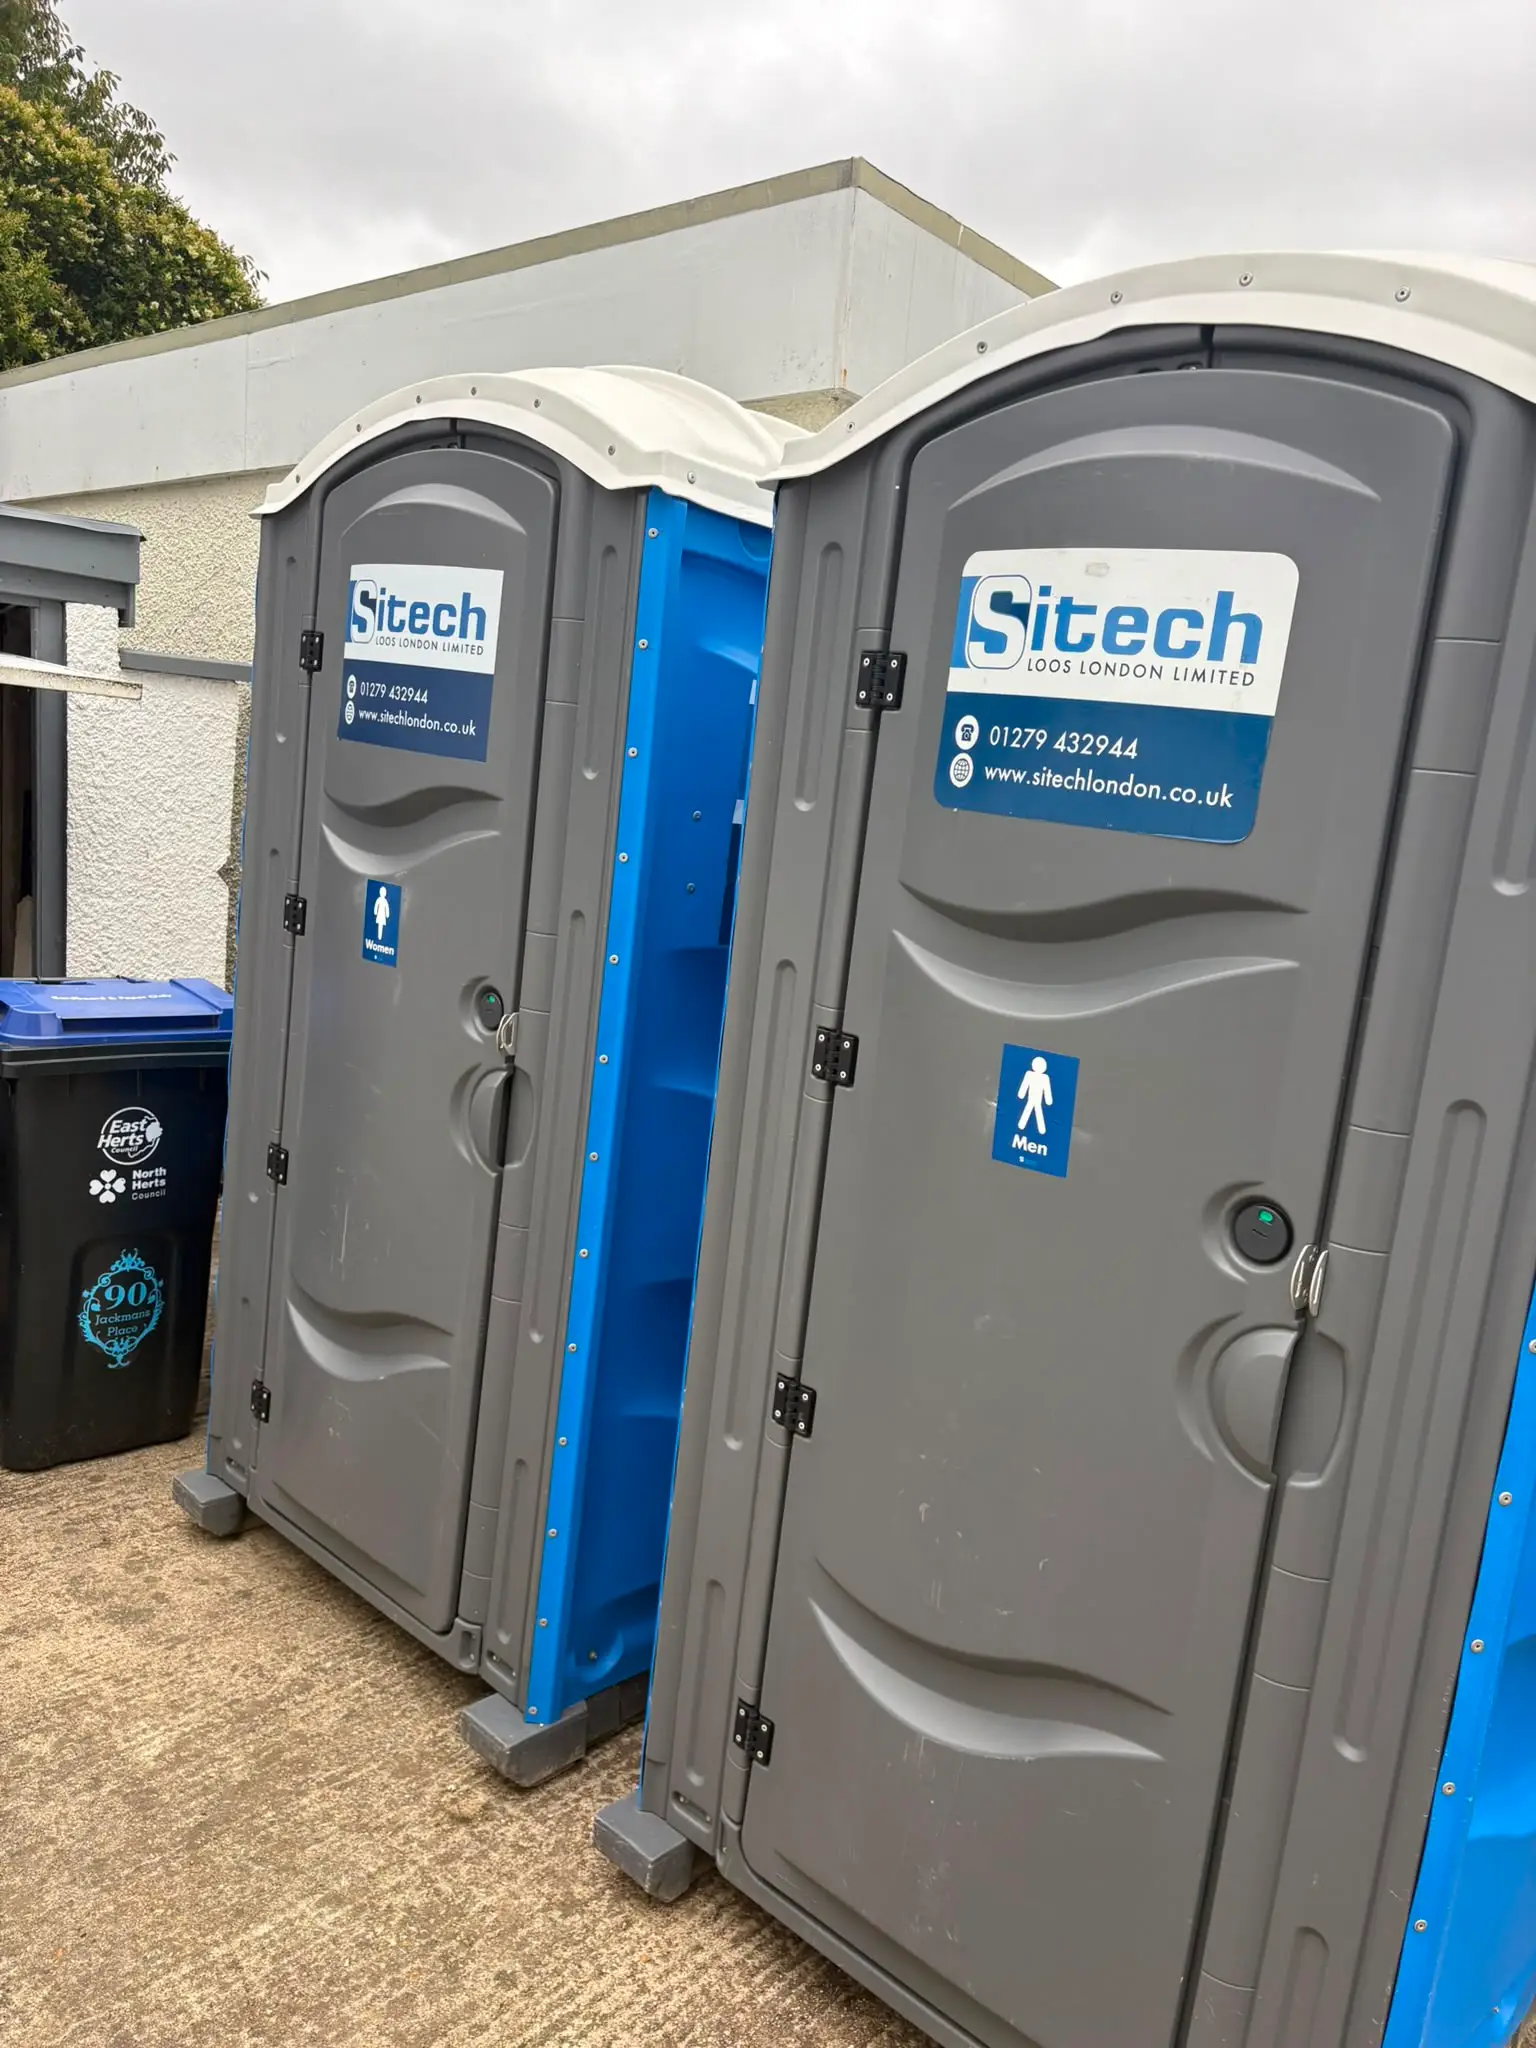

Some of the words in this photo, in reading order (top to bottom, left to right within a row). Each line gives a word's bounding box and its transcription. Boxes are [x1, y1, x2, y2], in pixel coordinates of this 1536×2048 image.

[351, 580, 487, 644] Sitech
[967, 575, 1264, 670] Sitech
[375, 636, 396, 648] LOOS
[399, 637, 439, 653] LONDON
[442, 643, 484, 656] LIMITED
[1027, 658, 1072, 674] LOOS
[1080, 661, 1163, 680] LONDON
[1173, 670, 1256, 687] LIMITED
[360, 682, 387, 699] 01279
[388, 687, 429, 704] 432944
[358, 708, 477, 737] www.sitechlondon.co.uk
[989, 725, 1048, 751] 01279
[1053, 732, 1139, 760] 432944
[984, 765, 1234, 808] www.sitechlondon.co.uk
[365, 938, 395, 956] Women
[109, 1119, 148, 1134] East
[97, 1134, 144, 1149] Herts
[111, 1146, 138, 1154] Council
[1011, 1134, 1048, 1156] Men
[132, 1167, 167, 1180] North
[131, 1189, 166, 1200] Council
[132, 1179, 166, 1190] Herts
[104, 1281, 147, 1311] 90
[95, 1310, 151, 1326] Jackmans
